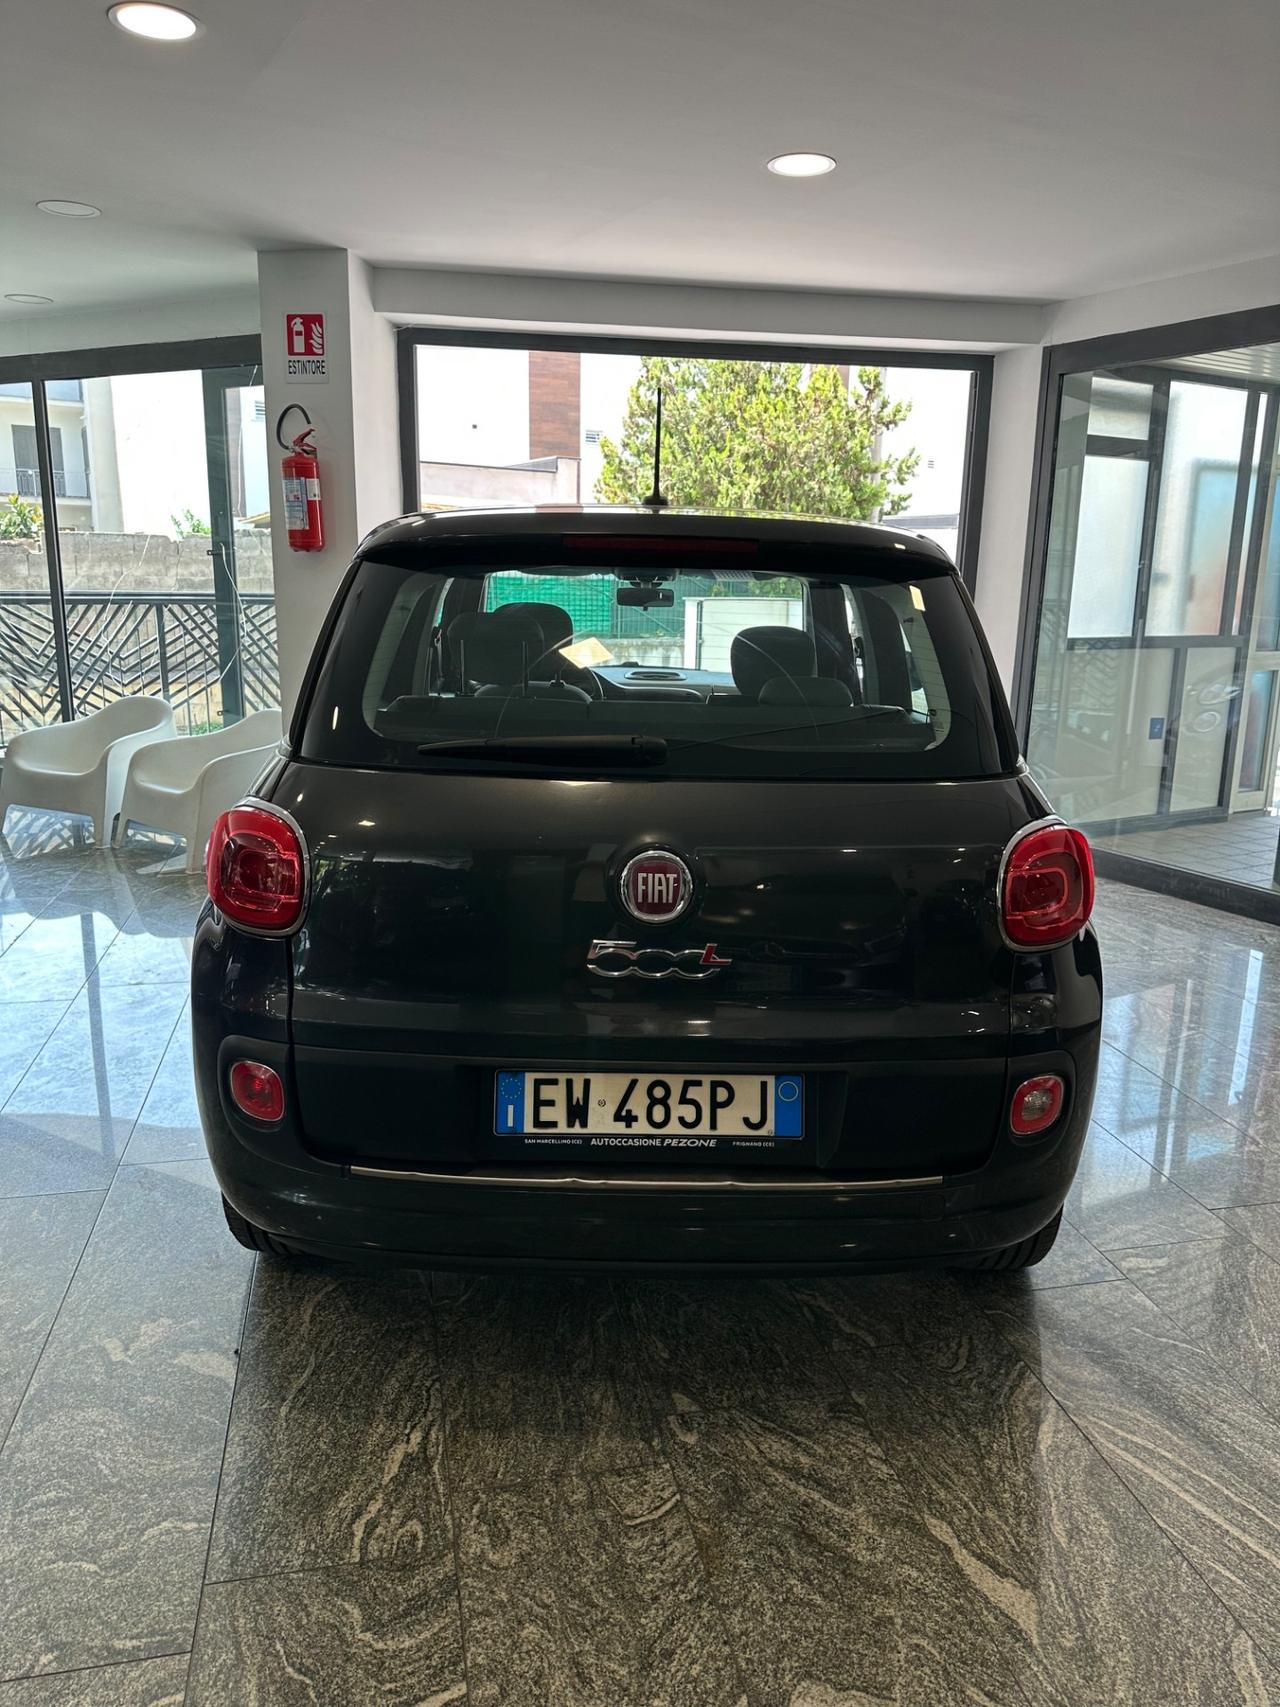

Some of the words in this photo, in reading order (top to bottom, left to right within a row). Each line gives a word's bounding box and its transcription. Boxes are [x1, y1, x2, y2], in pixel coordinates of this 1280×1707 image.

[288, 360, 325, 375] ESTINTORE
[637, 872, 677, 903] FIAT
[507, 1104, 514, 1127] I
[532, 1078, 591, 1129] EW
[612, 1078, 769, 1131] 485PJ
[590, 1138, 661, 1147] AUTOCCASIONE
[663, 1138, 717, 1148] PEZONE
